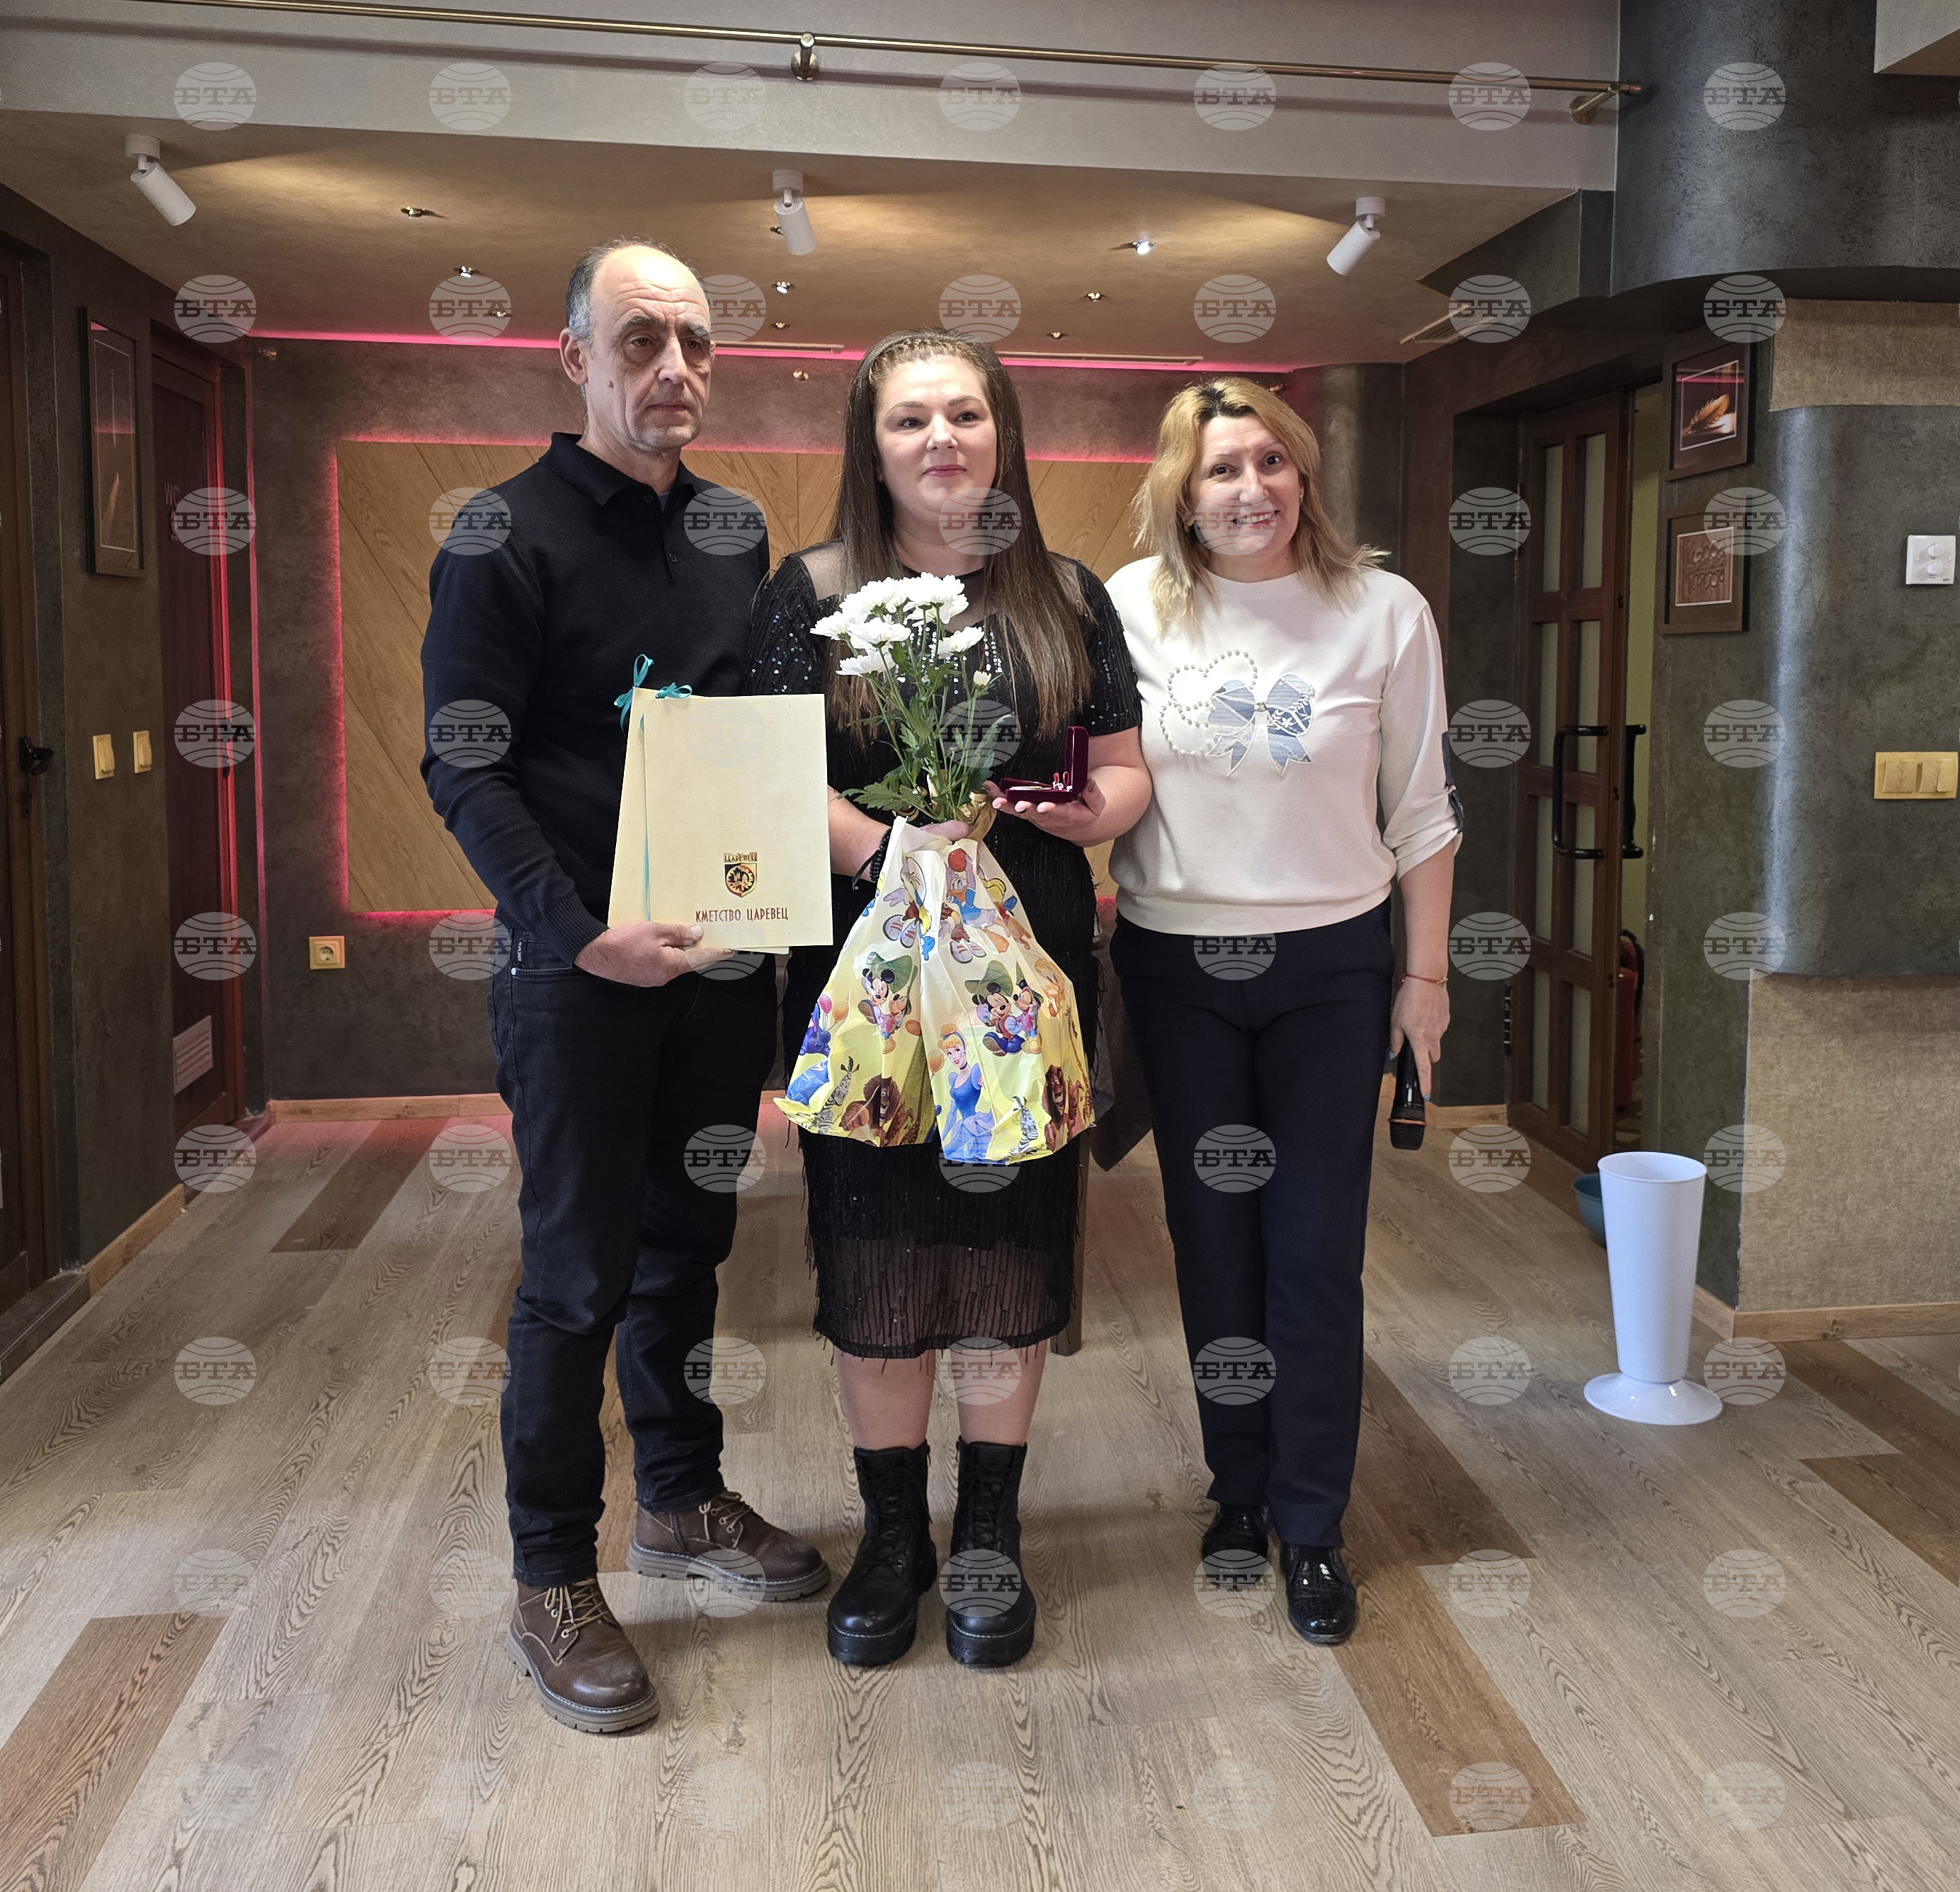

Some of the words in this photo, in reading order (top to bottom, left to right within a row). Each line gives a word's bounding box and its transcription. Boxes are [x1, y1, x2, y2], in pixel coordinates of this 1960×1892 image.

[164, 481, 180, 508] WC
[724, 853, 757, 862] ЦАРЕВЕЦ
[695, 909, 741, 923] КМЕТСТВО
[746, 907, 789, 921] ЦАРЕВЕЦ
